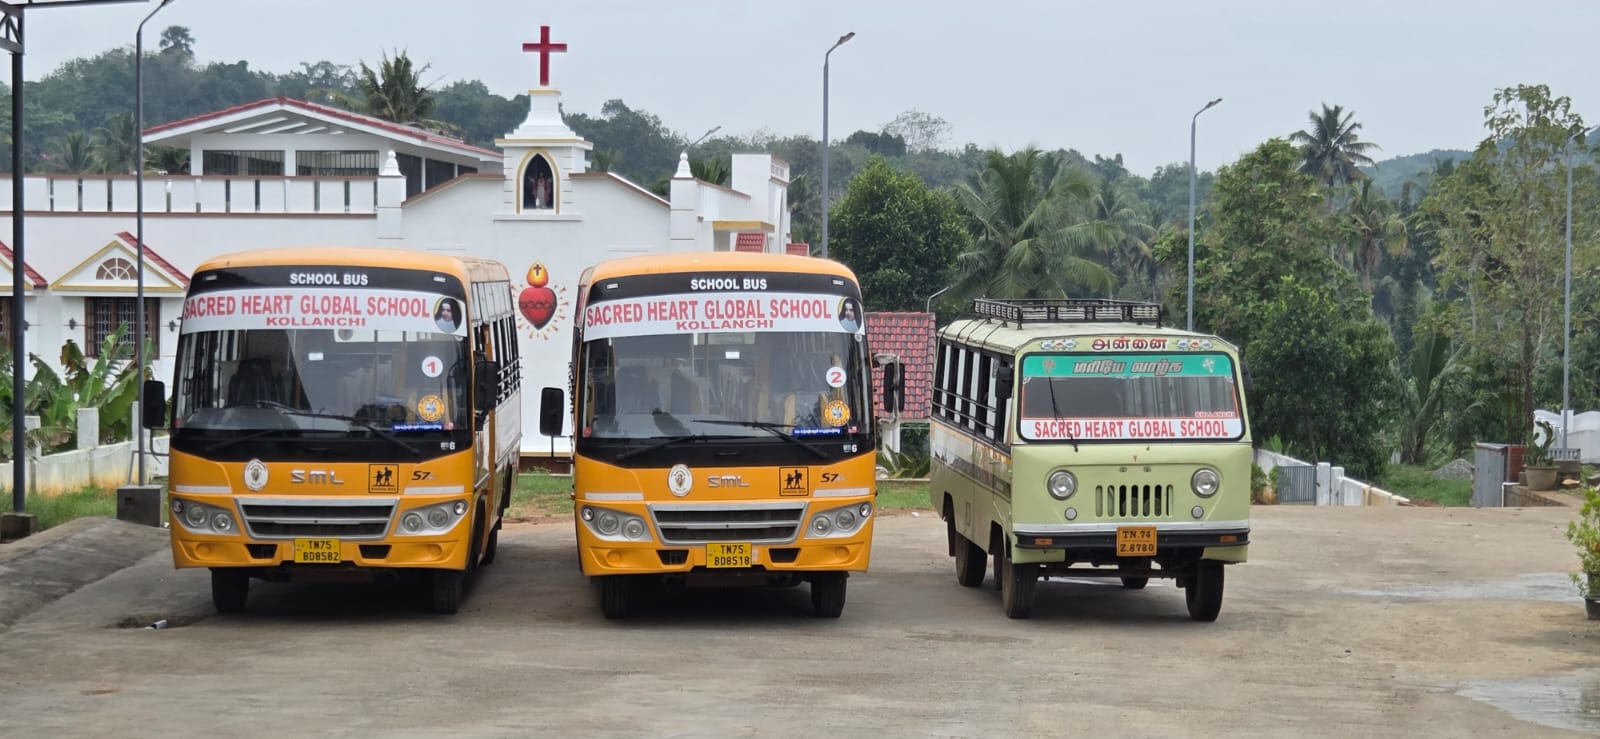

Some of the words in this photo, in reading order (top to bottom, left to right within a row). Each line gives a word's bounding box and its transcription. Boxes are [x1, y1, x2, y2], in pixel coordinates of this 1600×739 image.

[290, 273, 340, 286] SCHOOL
[344, 274, 368, 286] BUS
[690, 278, 740, 290] SCHOOL
[744, 278, 768, 290] BUS
[184, 296, 236, 320] SACRED
[241, 295, 293, 314] HEART
[300, 295, 362, 316] GLOBAL
[366, 297, 430, 318] SCHOOL
[586, 303, 643, 328] SACRED
[649, 300, 698, 321] HEART
[704, 299, 767, 320] GLOBAL
[770, 298, 832, 319] SCHOOL
[266, 317, 366, 327] KOLLANCHI
[676, 319, 774, 330] KOLLANCHI
[1092, 336, 1168, 351] அன்னை
[427, 361, 436, 374] 1
[1073, 359, 1127, 375] மரியே
[1130, 358, 1183, 376] வாழ்க
[831, 372, 842, 383] 2
[1034, 420, 1082, 438] SACRED
[1085, 421, 1124, 438] HEART
[1128, 420, 1176, 438] GLOBAL
[1180, 420, 1228, 436] SCHOOL
[308, 540, 332, 550] TN75
[720, 545, 744, 554] TN75
[303, 552, 339, 561] BD8582
[714, 556, 750, 566] BD8518
